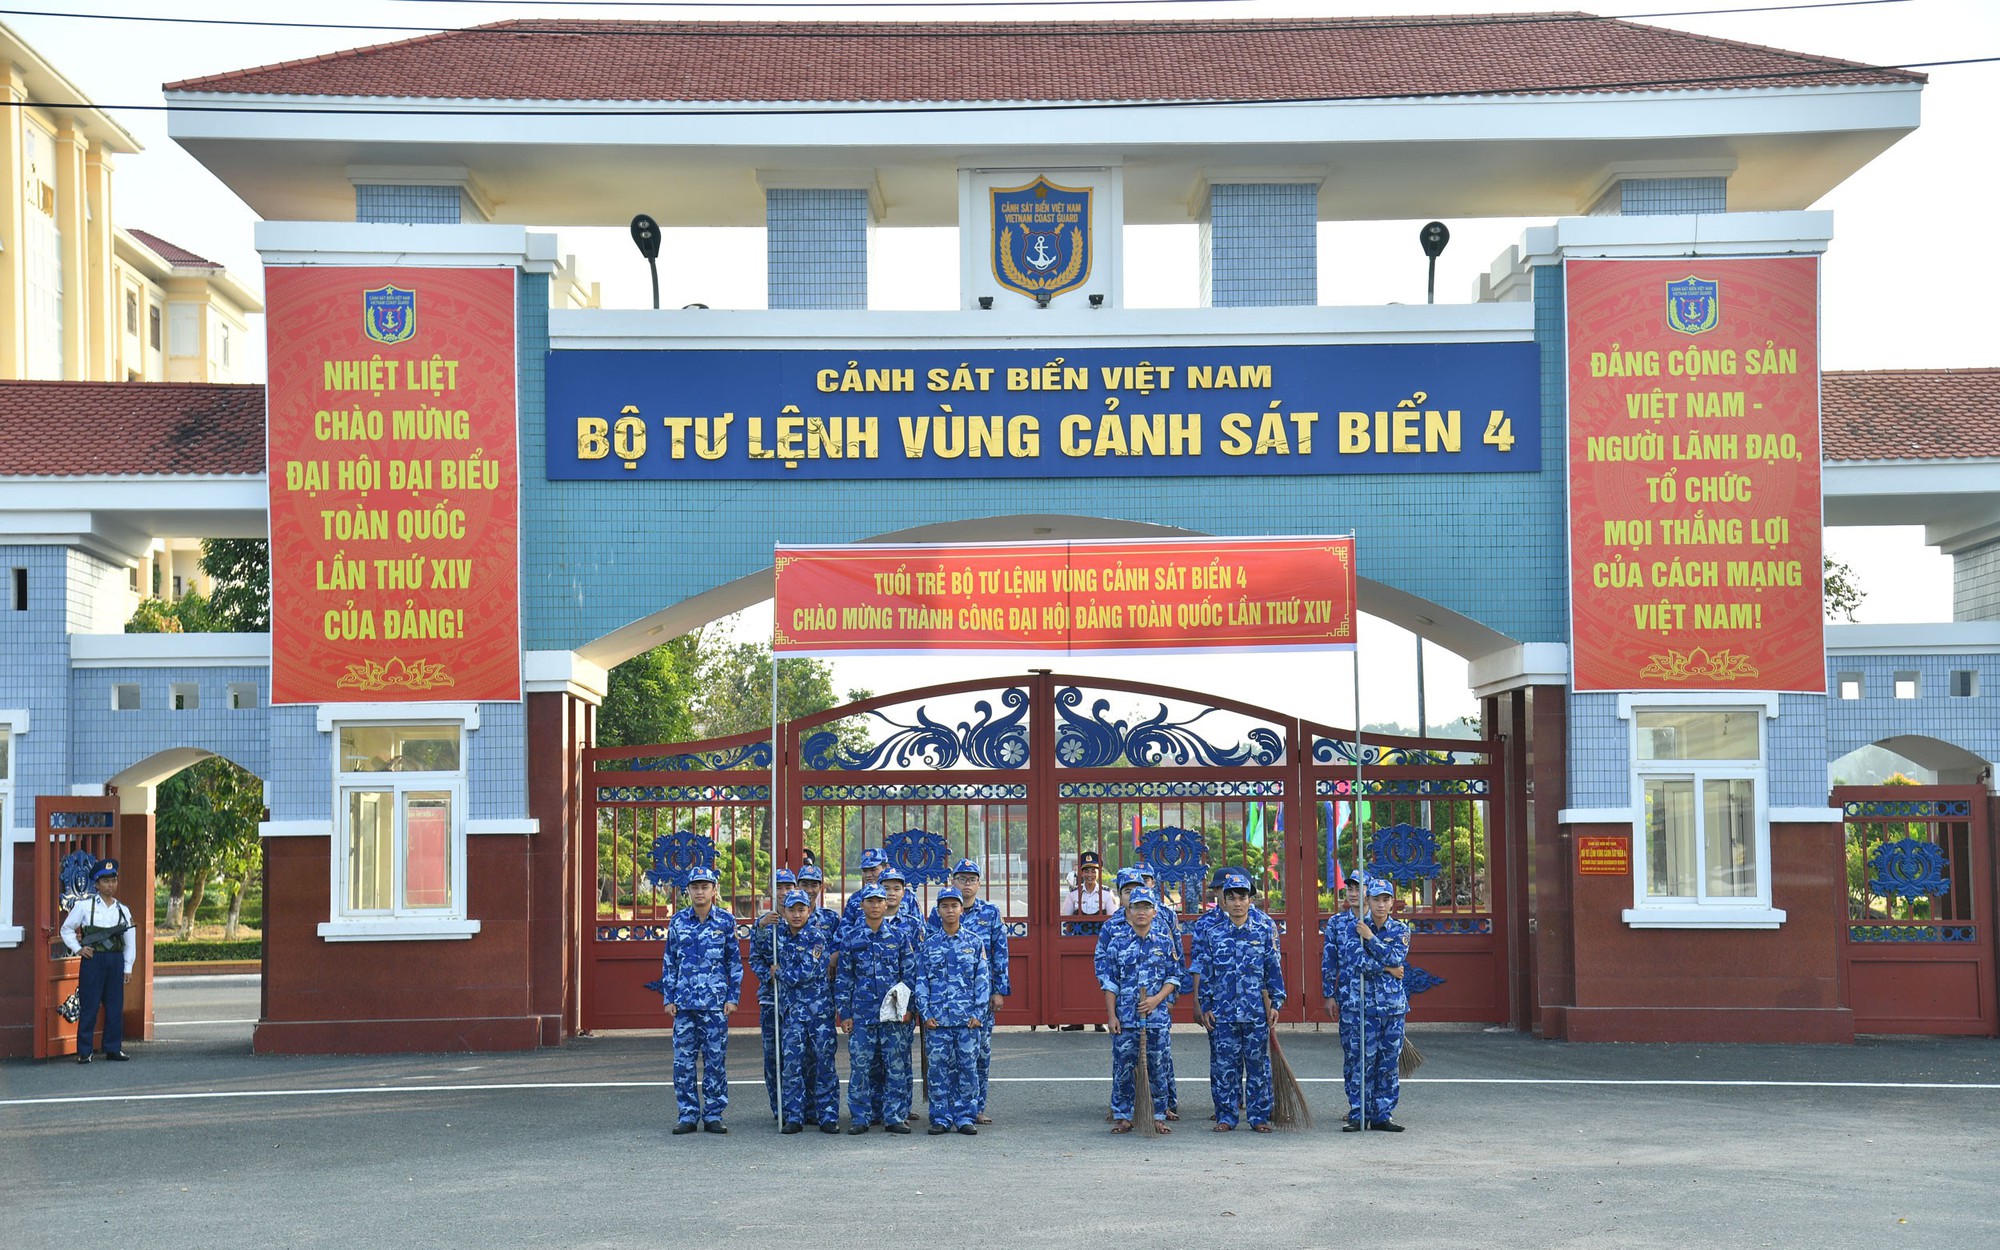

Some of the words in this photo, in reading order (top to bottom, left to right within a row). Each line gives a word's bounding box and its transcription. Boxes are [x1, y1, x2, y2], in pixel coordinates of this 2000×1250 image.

[1002, 202, 1019, 213] CẢNH
[1020, 202, 1034, 213] SÁT
[1035, 200, 1049, 213] BIỂN
[1067, 203, 1081, 213] NAM
[1005, 214, 1032, 223] VIETNAM
[1034, 214, 1055, 223] COAST
[1057, 213, 1078, 223] GUARD
[323, 354, 399, 397] NHIỆT
[407, 354, 459, 397] LIỆT
[816, 360, 915, 393] CẢNH
[927, 362, 995, 392] SÁT
[1006, 357, 1089, 392] BIỂN
[1101, 361, 1174, 395] VIỆT
[1187, 365, 1273, 389] NAM
[1590, 343, 1660, 378] ĐẢNG
[1668, 345, 1737, 381] CỘNG
[1745, 340, 1797, 375] SẢN
[314, 404, 384, 441] CHÀO
[392, 404, 470, 440] MỪNG
[1626, 387, 1679, 424] VIỆT
[1686, 391, 1745, 418] NAM
[577, 404, 648, 470] BỘ
[663, 412, 735, 460] TƯ
[748, 405, 879, 470] LỆNH
[898, 404, 1040, 459] VÙNG
[1060, 397, 1201, 457] CẢNH
[1219, 400, 1319, 456] SÁT
[1338, 391, 1462, 454] BIỂN
[1482, 409, 1516, 453] 4
[1587, 429, 1665, 462] NGƯỜI
[1672, 429, 1739, 461] LÃNH
[1745, 433, 1803, 466] ĐẠO,
[286, 460, 330, 498] ĐẠI
[338, 454, 381, 497] HỘI
[389, 460, 432, 497] ĐẠI
[441, 447, 499, 490] BIỂU
[1646, 466, 1678, 503] TỔ
[1685, 470, 1752, 502] CHỨC
[320, 503, 389, 541] TOÀN
[397, 498, 466, 543] QUỐC
[1604, 519, 1652, 552] MỌI
[1660, 509, 1743, 545] THẮNG
[1751, 515, 1789, 550] LỢI
[316, 549, 366, 590] LẦN
[374, 552, 426, 589] THỨ
[430, 559, 472, 589] XIV
[874, 563, 911, 596] TUỔI
[916, 564, 946, 595] TRẺ
[951, 567, 974, 600] BỘ
[978, 568, 1001, 594] TƯ
[1004, 566, 1047, 599] LỆNH
[1051, 565, 1097, 592] VÙNG
[1102, 560, 1149, 592] CẢNH
[1154, 562, 1187, 591] SÁT
[1191, 556, 1232, 590] BIỂN
[1236, 566, 1247, 589] 4
[1593, 553, 1644, 588] CỦA
[1651, 556, 1718, 587] CÁCH
[1726, 560, 1803, 593] MẠNG
[324, 600, 377, 641] CỦA
[383, 599, 464, 640] ĐẢNG!
[793, 603, 837, 631] CHÀO
[842, 603, 893, 630] MỪNG
[898, 604, 953, 630] THÀNH
[958, 603, 1004, 631] CÔNG
[1008, 608, 1037, 636] ĐẠI
[1042, 602, 1070, 635] HỘI
[1075, 598, 1123, 630] ĐẢNG
[1127, 600, 1173, 628] TOÀN
[1177, 595, 1223, 629] QUỐC
[1228, 595, 1262, 626] LẦN
[1266, 596, 1301, 625] THỨ
[1304, 600, 1332, 624] XIV
[1633, 599, 1686, 635] VIỆT
[1694, 604, 1762, 629] NAM!
